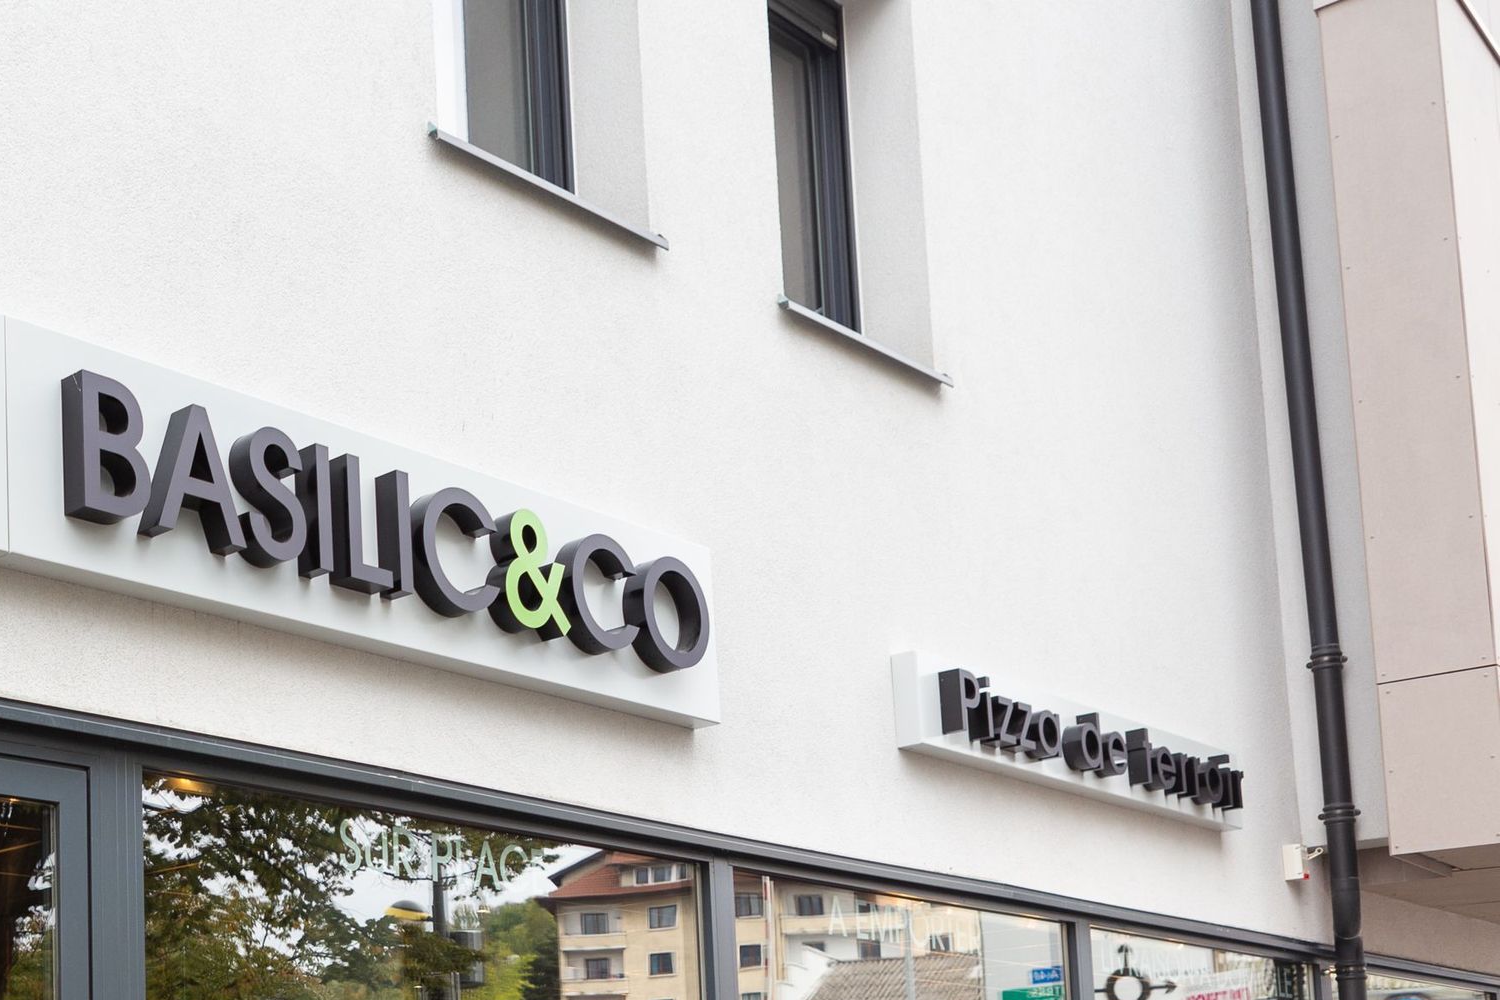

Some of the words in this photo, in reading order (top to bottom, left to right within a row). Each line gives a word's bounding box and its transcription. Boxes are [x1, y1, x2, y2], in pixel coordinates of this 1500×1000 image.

[61, 369, 710, 674] BASILIC&CO
[938, 668, 1061, 760] Pizza
[1062, 711, 1128, 778] de
[1125, 727, 1244, 810] terroir
[339, 817, 418, 880] SUR
